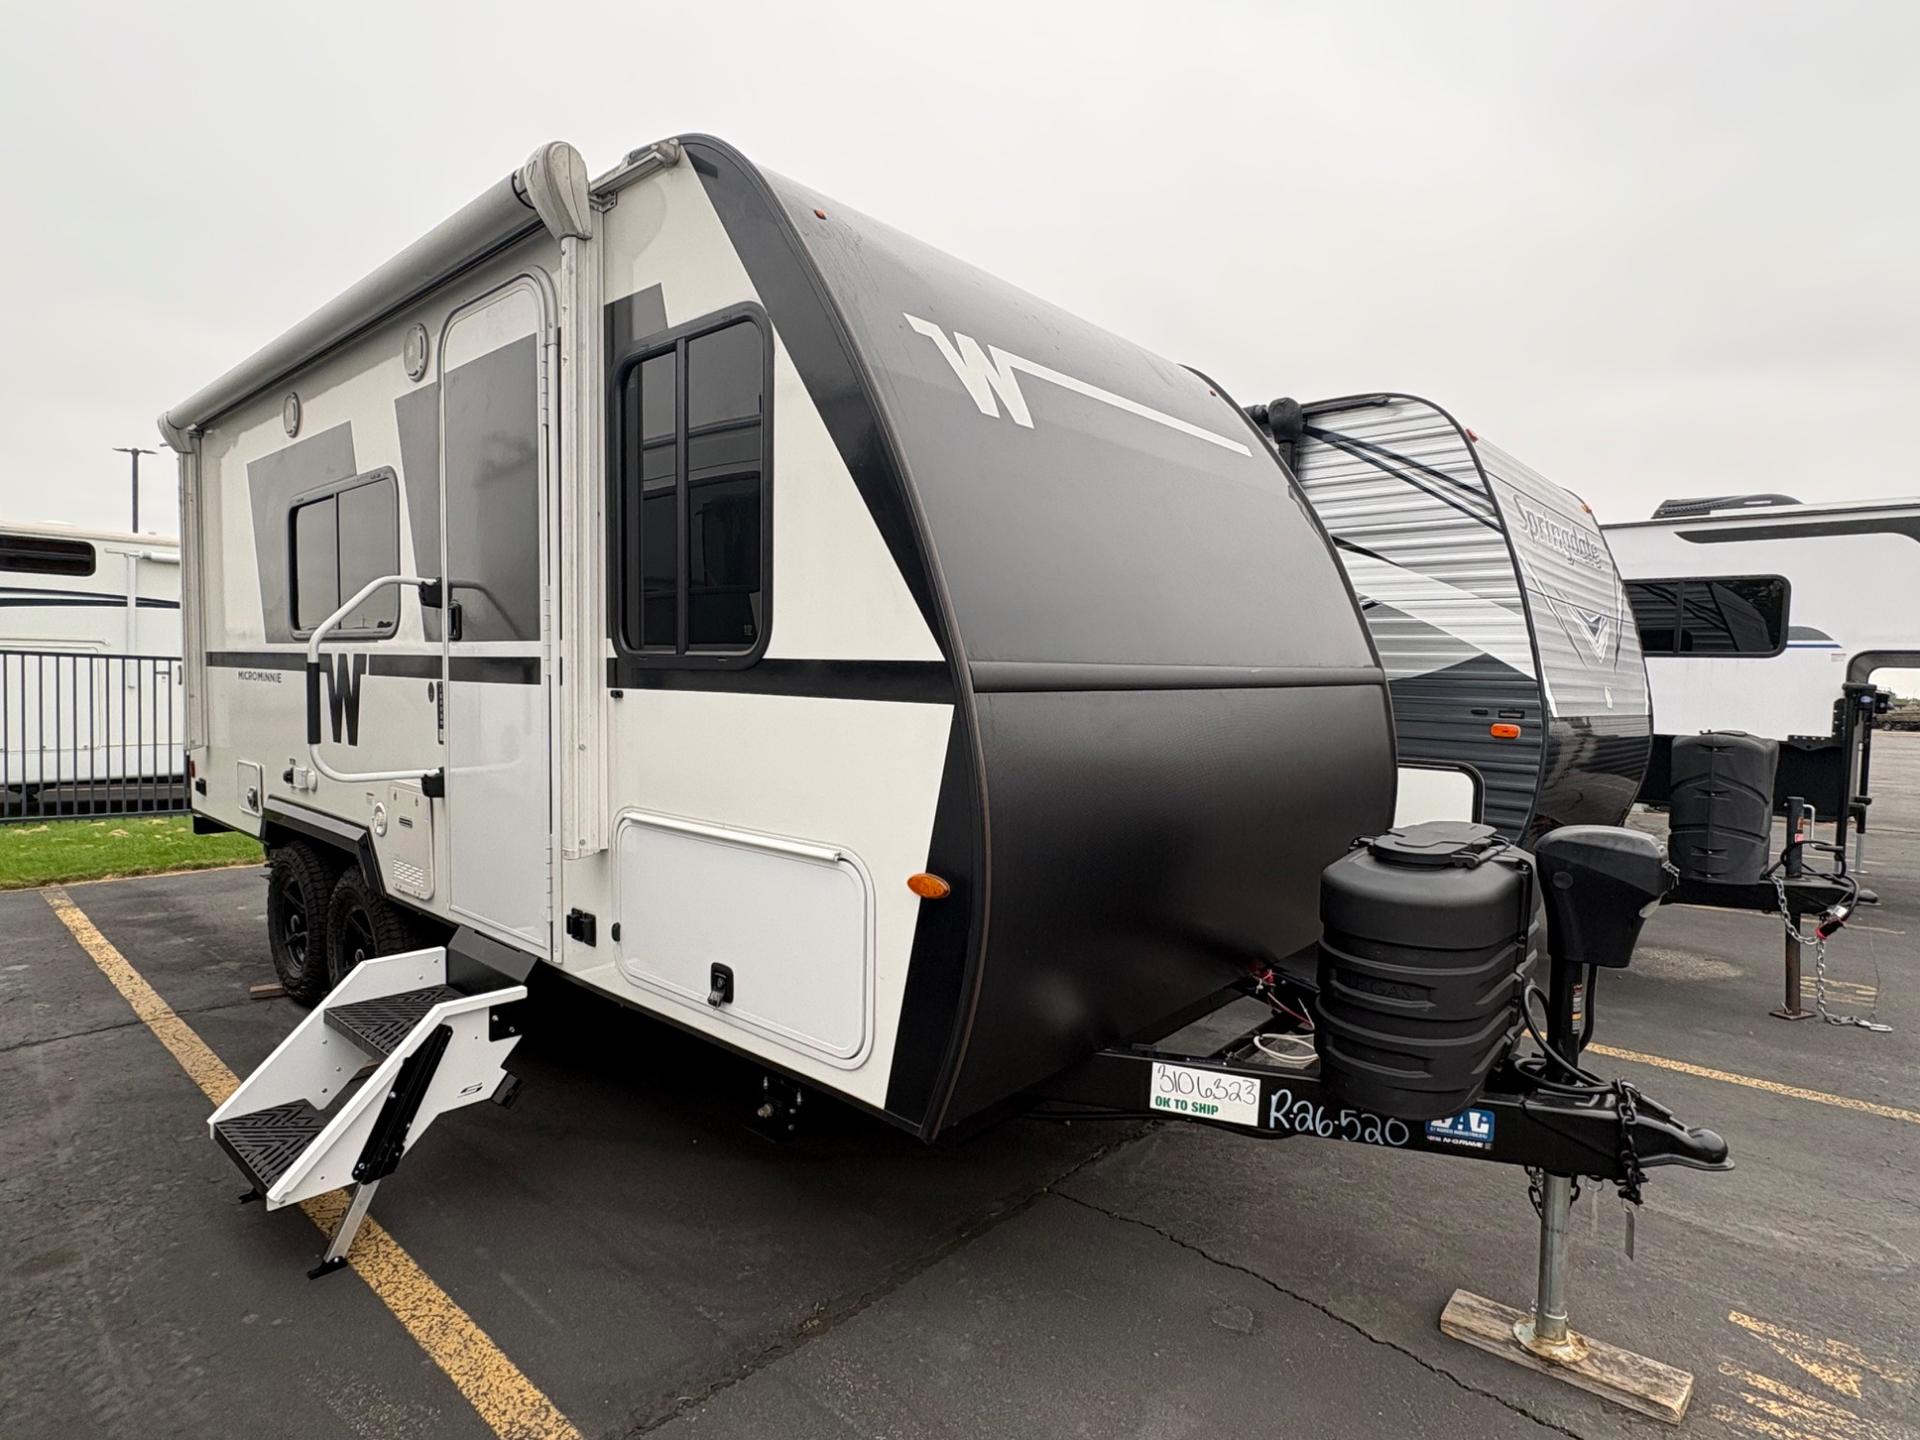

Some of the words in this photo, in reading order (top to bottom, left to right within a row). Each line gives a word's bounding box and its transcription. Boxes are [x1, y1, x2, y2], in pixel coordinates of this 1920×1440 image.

[1155, 1095, 1171, 1109] OK
[1174, 1098, 1188, 1111] TO
[1191, 1101, 1219, 1115] SHIP
